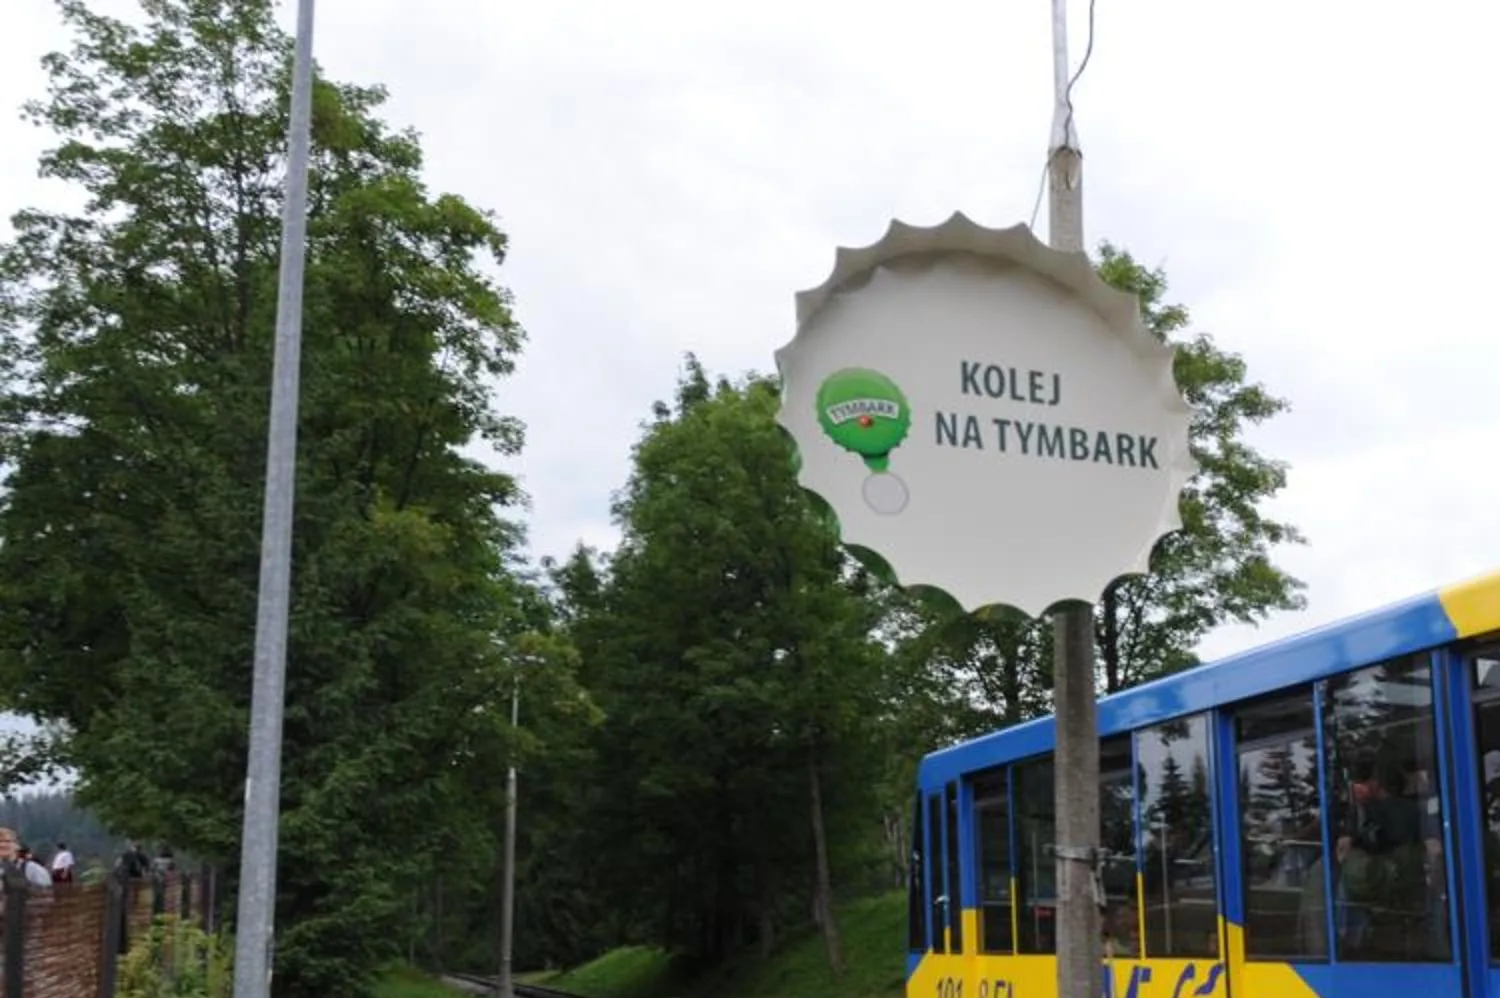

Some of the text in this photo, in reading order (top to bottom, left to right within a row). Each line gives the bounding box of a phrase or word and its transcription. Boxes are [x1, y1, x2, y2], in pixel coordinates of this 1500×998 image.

[960, 361, 1061, 406] KOLEJ
[935, 411, 1160, 469] NA TYMBARK
